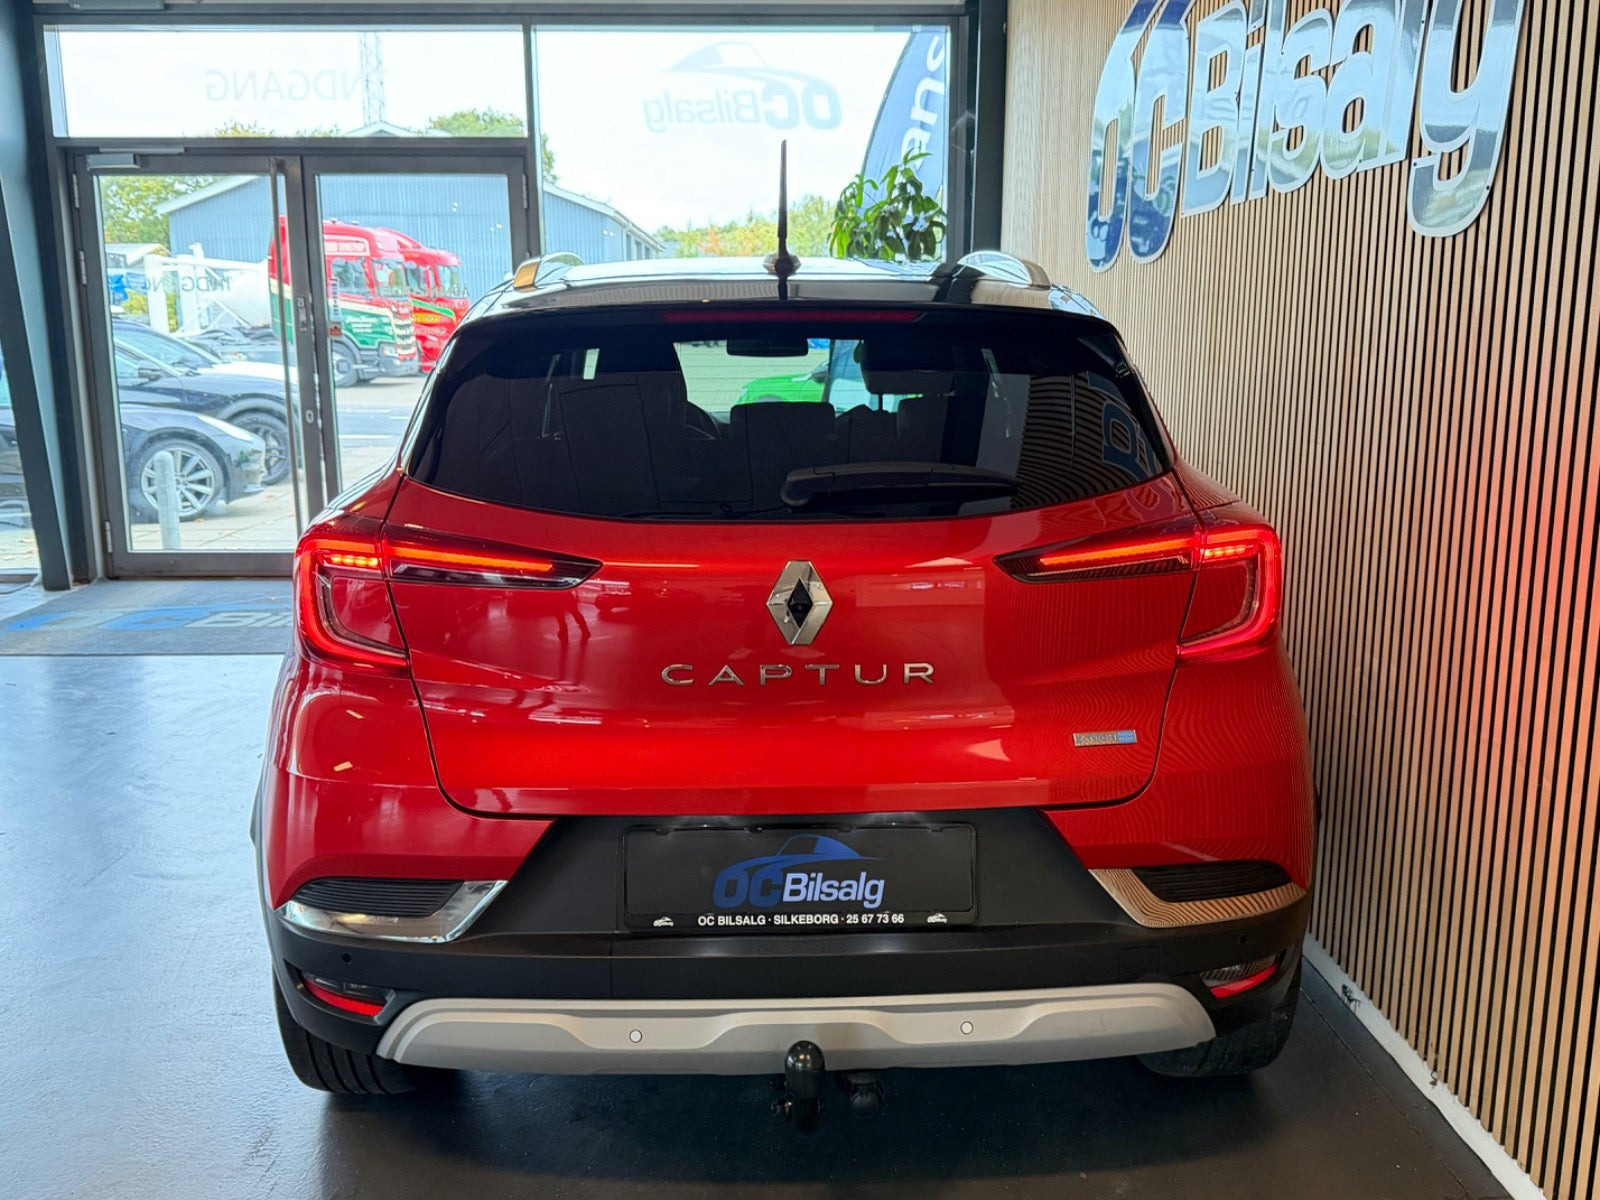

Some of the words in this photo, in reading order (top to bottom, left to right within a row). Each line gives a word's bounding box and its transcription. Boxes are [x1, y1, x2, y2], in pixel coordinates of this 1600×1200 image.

[661, 662, 934, 686] CAPTUR
[697, 915, 715, 926] OC
[717, 914, 766, 926] BILSALG
[773, 913, 839, 925] SILKEBORG
[846, 913, 859, 925] 25
[861, 913, 874, 925] 67
[876, 912, 889, 924] 73
[891, 912, 905, 924] 66
